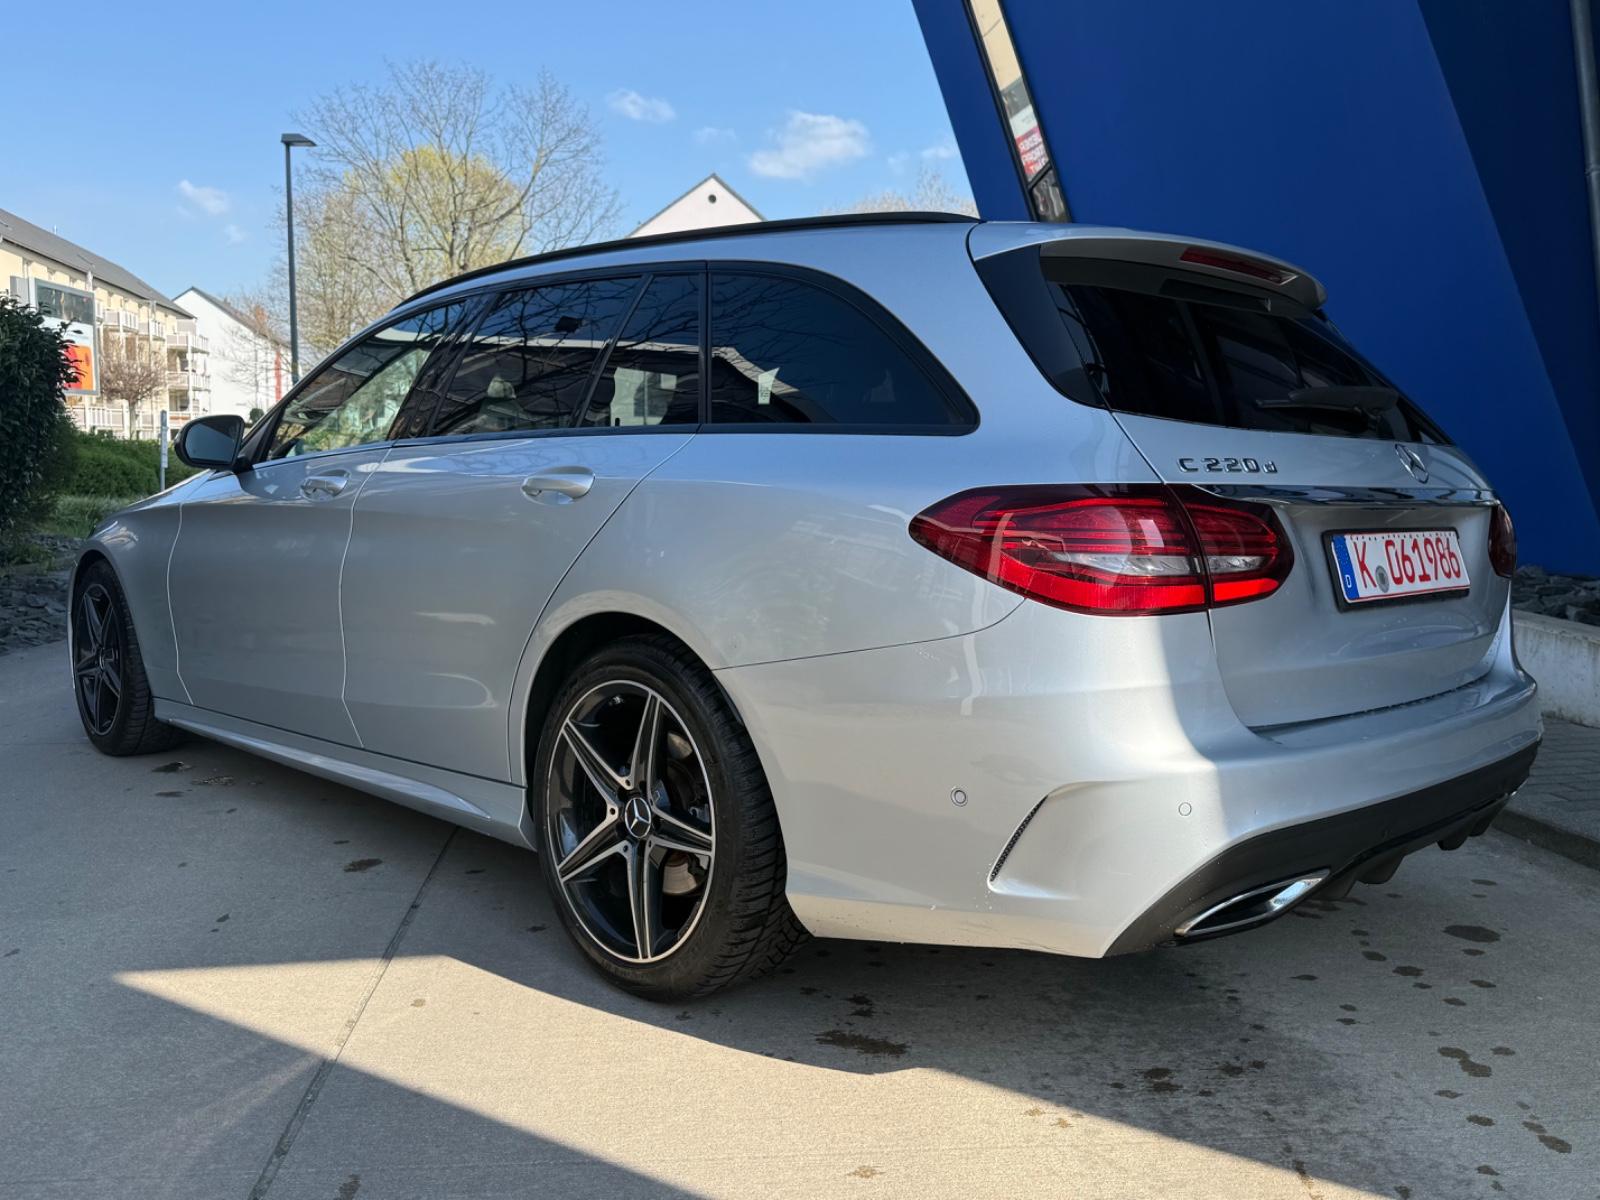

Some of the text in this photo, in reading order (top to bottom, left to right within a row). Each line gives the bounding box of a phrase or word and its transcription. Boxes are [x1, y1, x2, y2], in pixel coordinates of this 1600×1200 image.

[1177, 457, 1199, 473] C
[1201, 457, 1260, 473] 220
[1353, 537, 1461, 589] K 061986
[1345, 574, 1352, 588] D
